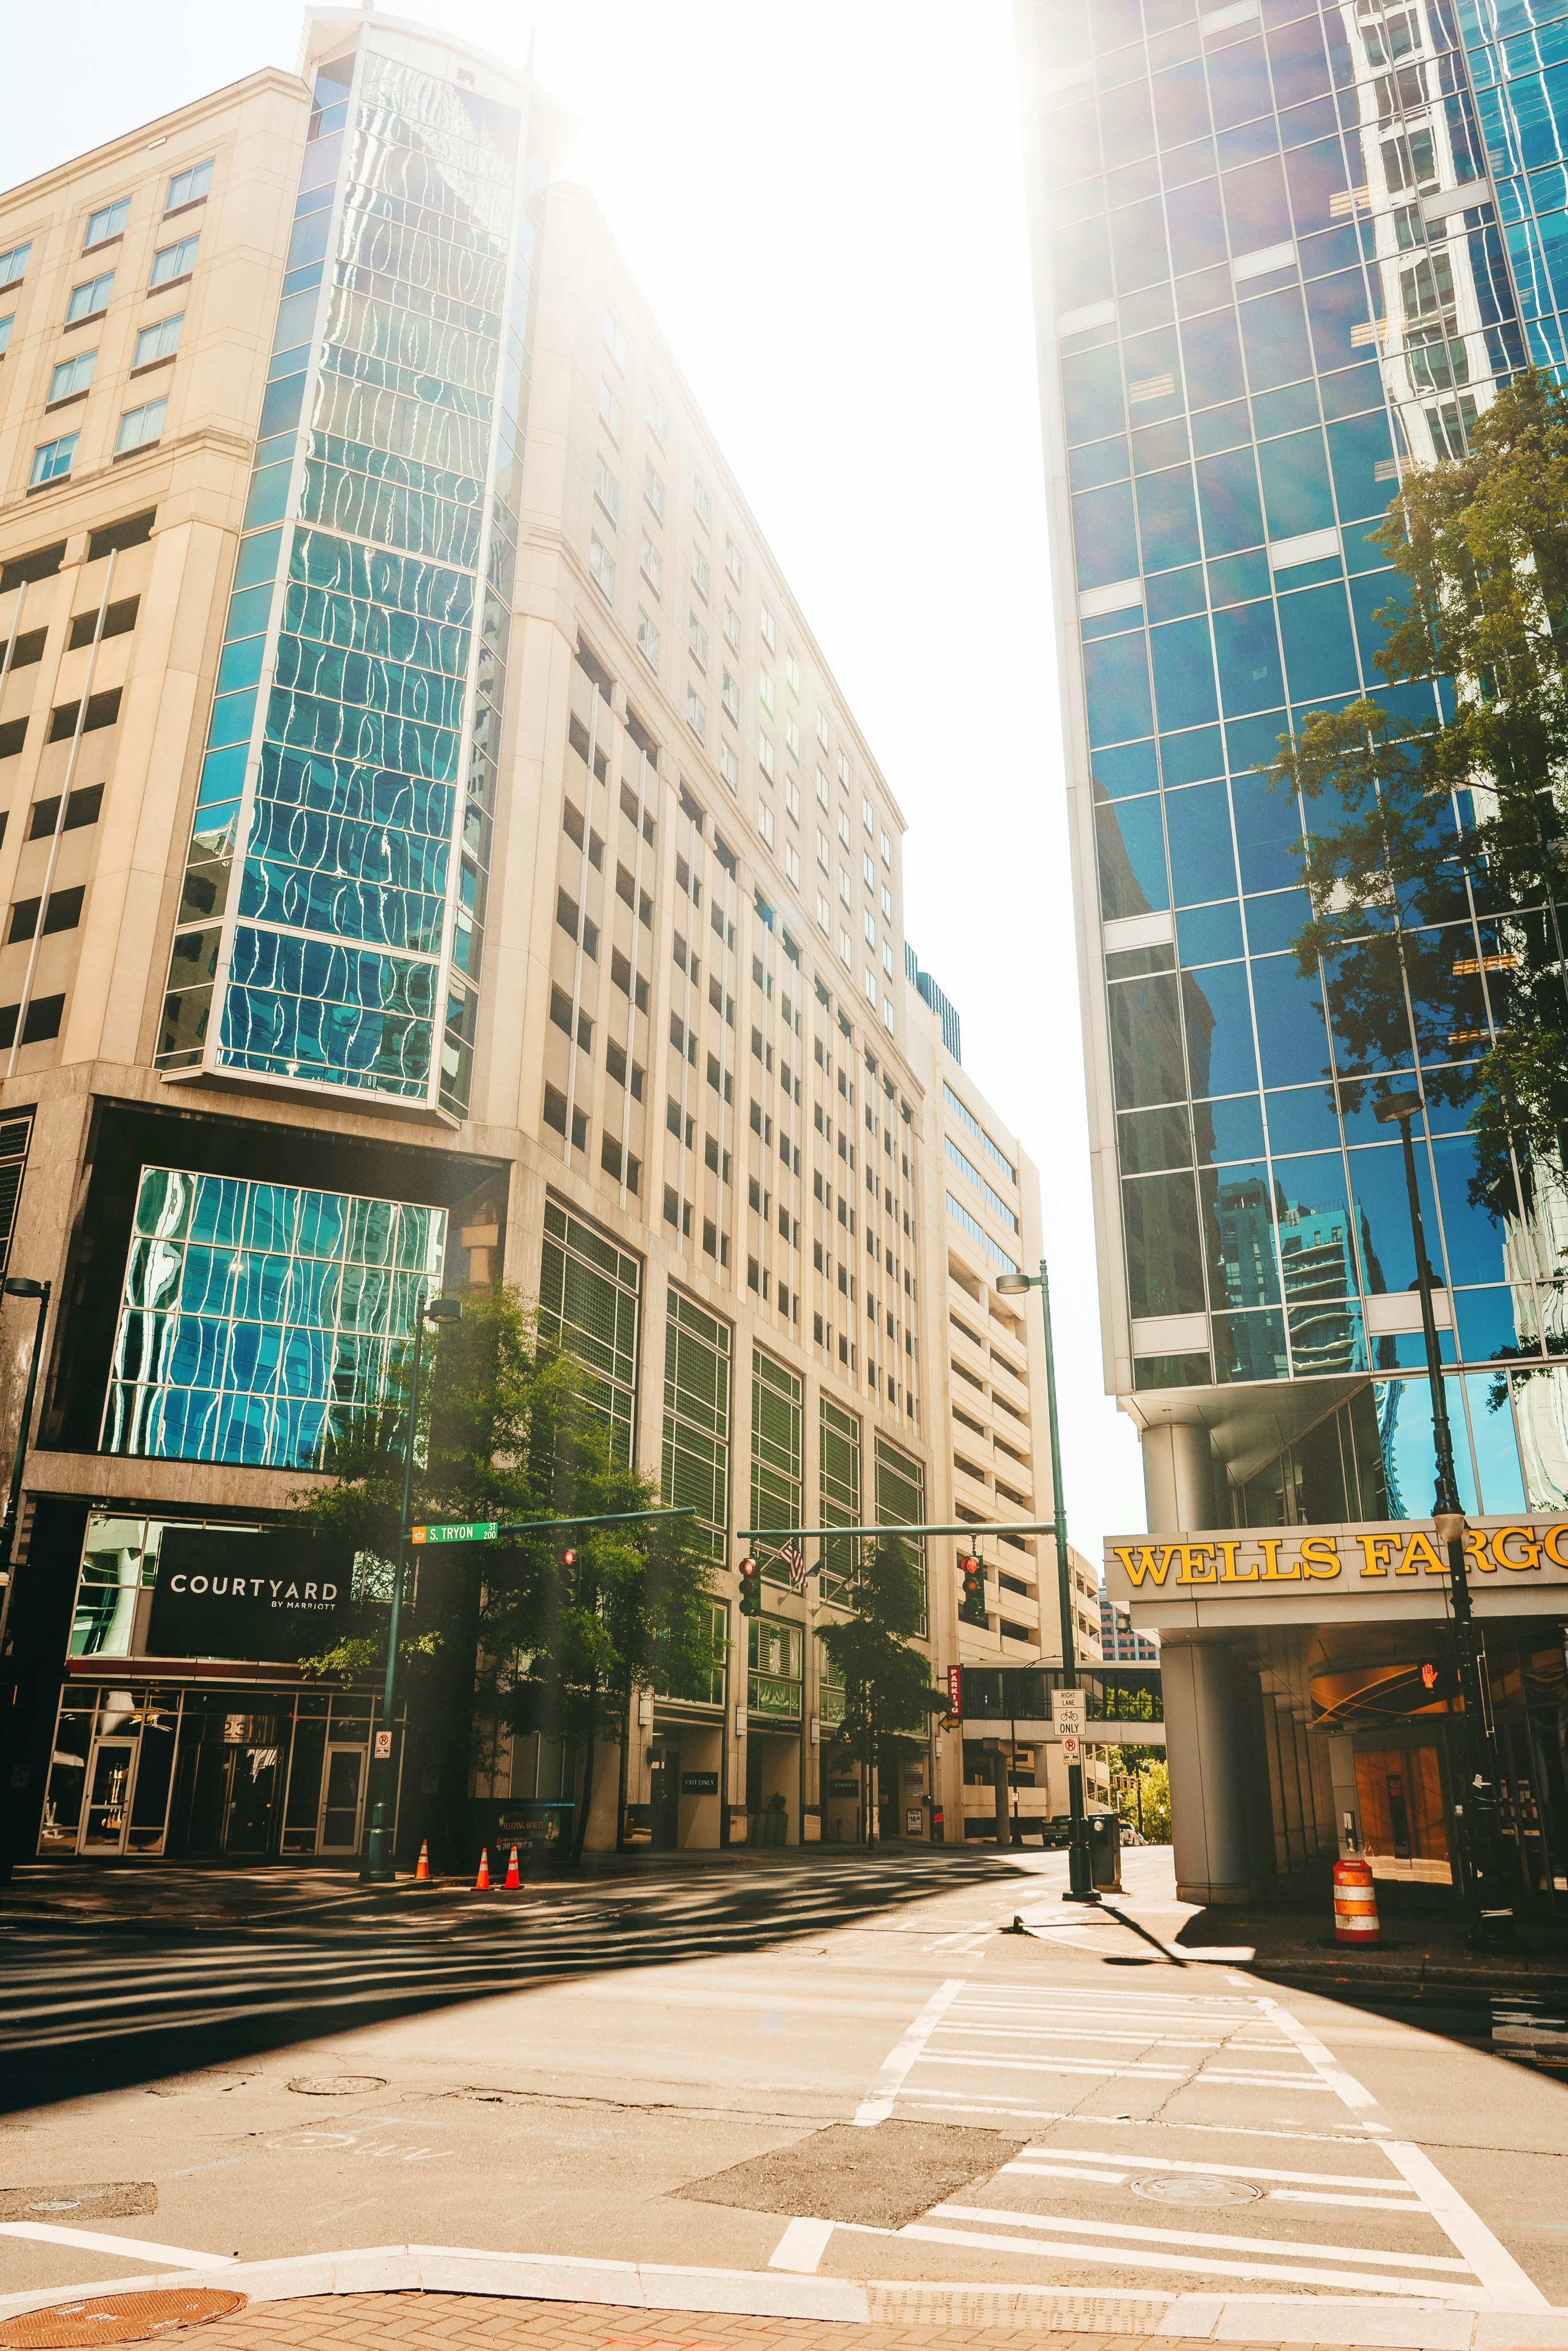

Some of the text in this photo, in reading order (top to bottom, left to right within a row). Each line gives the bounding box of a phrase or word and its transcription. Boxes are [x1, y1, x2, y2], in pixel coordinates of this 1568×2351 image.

[488, 1523, 496, 1531] ST
[429, 1526, 473, 1541] S. TRYON
[483, 1531, 496, 1539] 200
[1114, 1537, 1342, 1587] WELLS
[170, 1574, 337, 1600] COURTYARD
[287, 1601, 336, 1611] MARRIOTT
[1059, 1723, 1080, 1734] ONLY
[503, 1822, 525, 1830] SLEEPING
